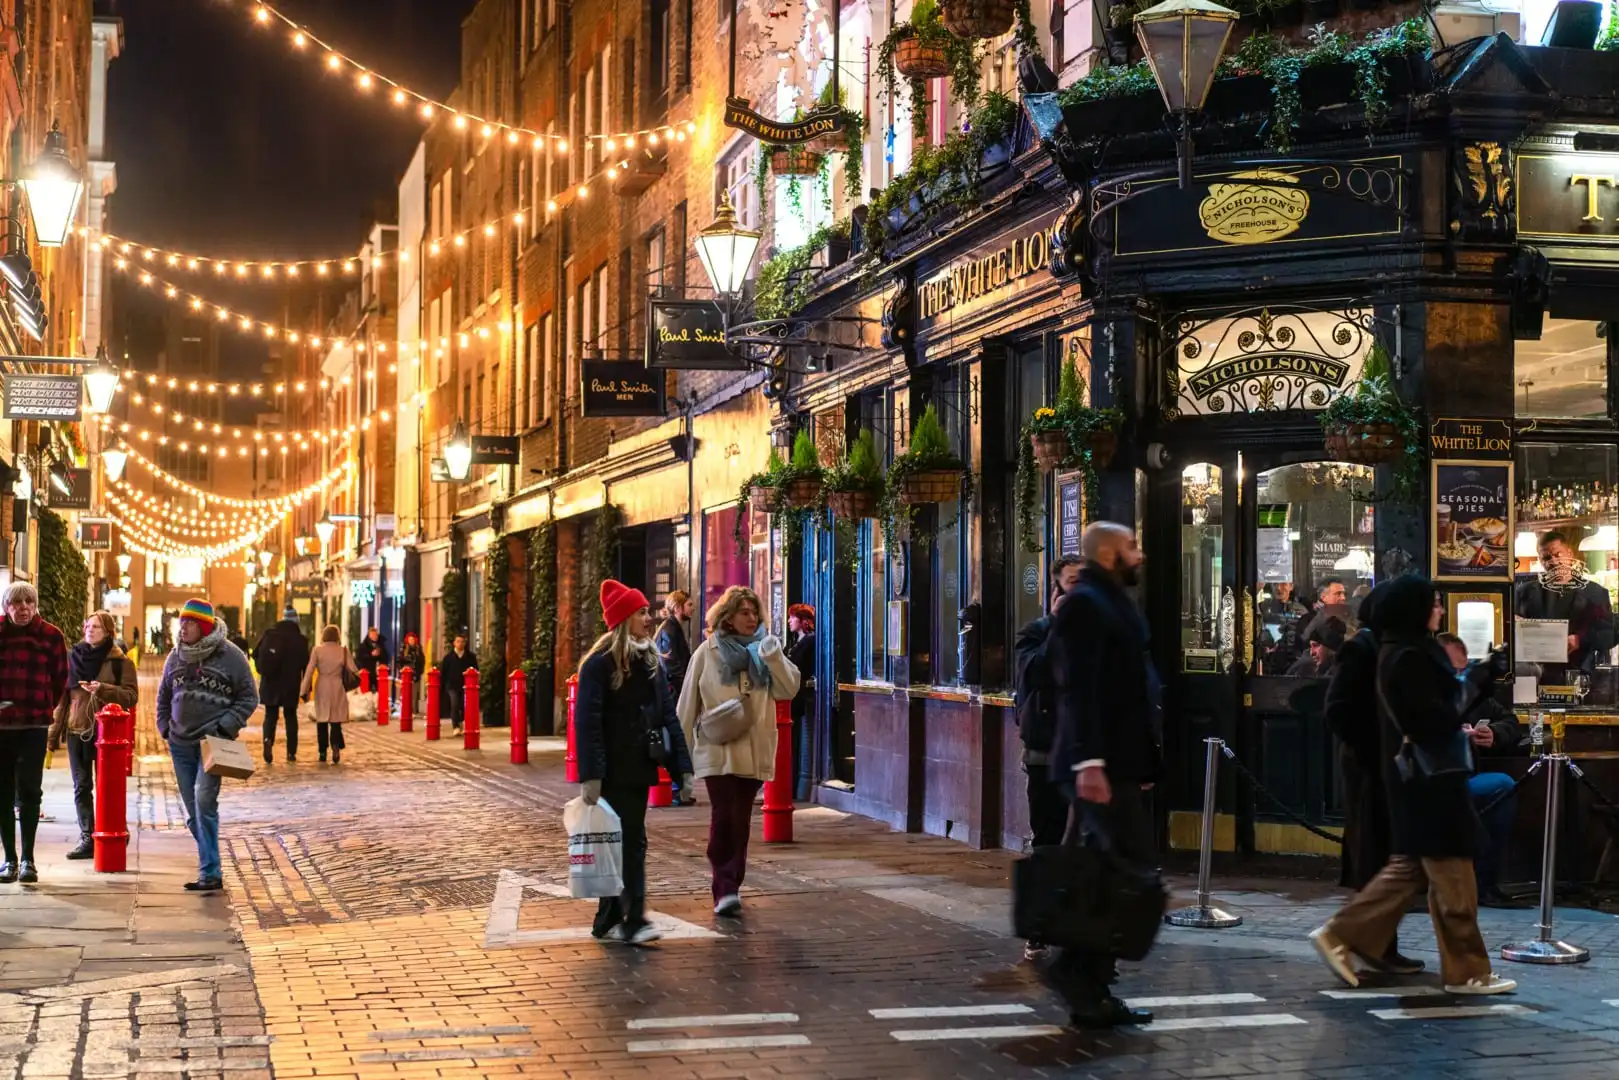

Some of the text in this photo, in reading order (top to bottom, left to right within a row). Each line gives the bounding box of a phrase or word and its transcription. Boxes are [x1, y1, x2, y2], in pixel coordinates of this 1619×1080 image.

[732, 111, 834, 139] THE WHITE LION
[1571, 174, 1619, 221] T
[1213, 196, 1295, 221] NICHOLSON'S
[1230, 219, 1277, 229] FREEHOUSE
[918, 275, 949, 320] THE
[950, 248, 1007, 305] WHITE
[660, 326, 726, 343] Paul Smit
[1196, 357, 1338, 391] NICHOLSON'S
[591, 378, 656, 394] Paul Smith
[9, 406, 76, 416] SKECHERS
[1460, 425, 1483, 435] THE
[1441, 495, 1502, 504] SEASONAL
[1458, 505, 1484, 513] PIES
[1314, 543, 1346, 553] SHARE
